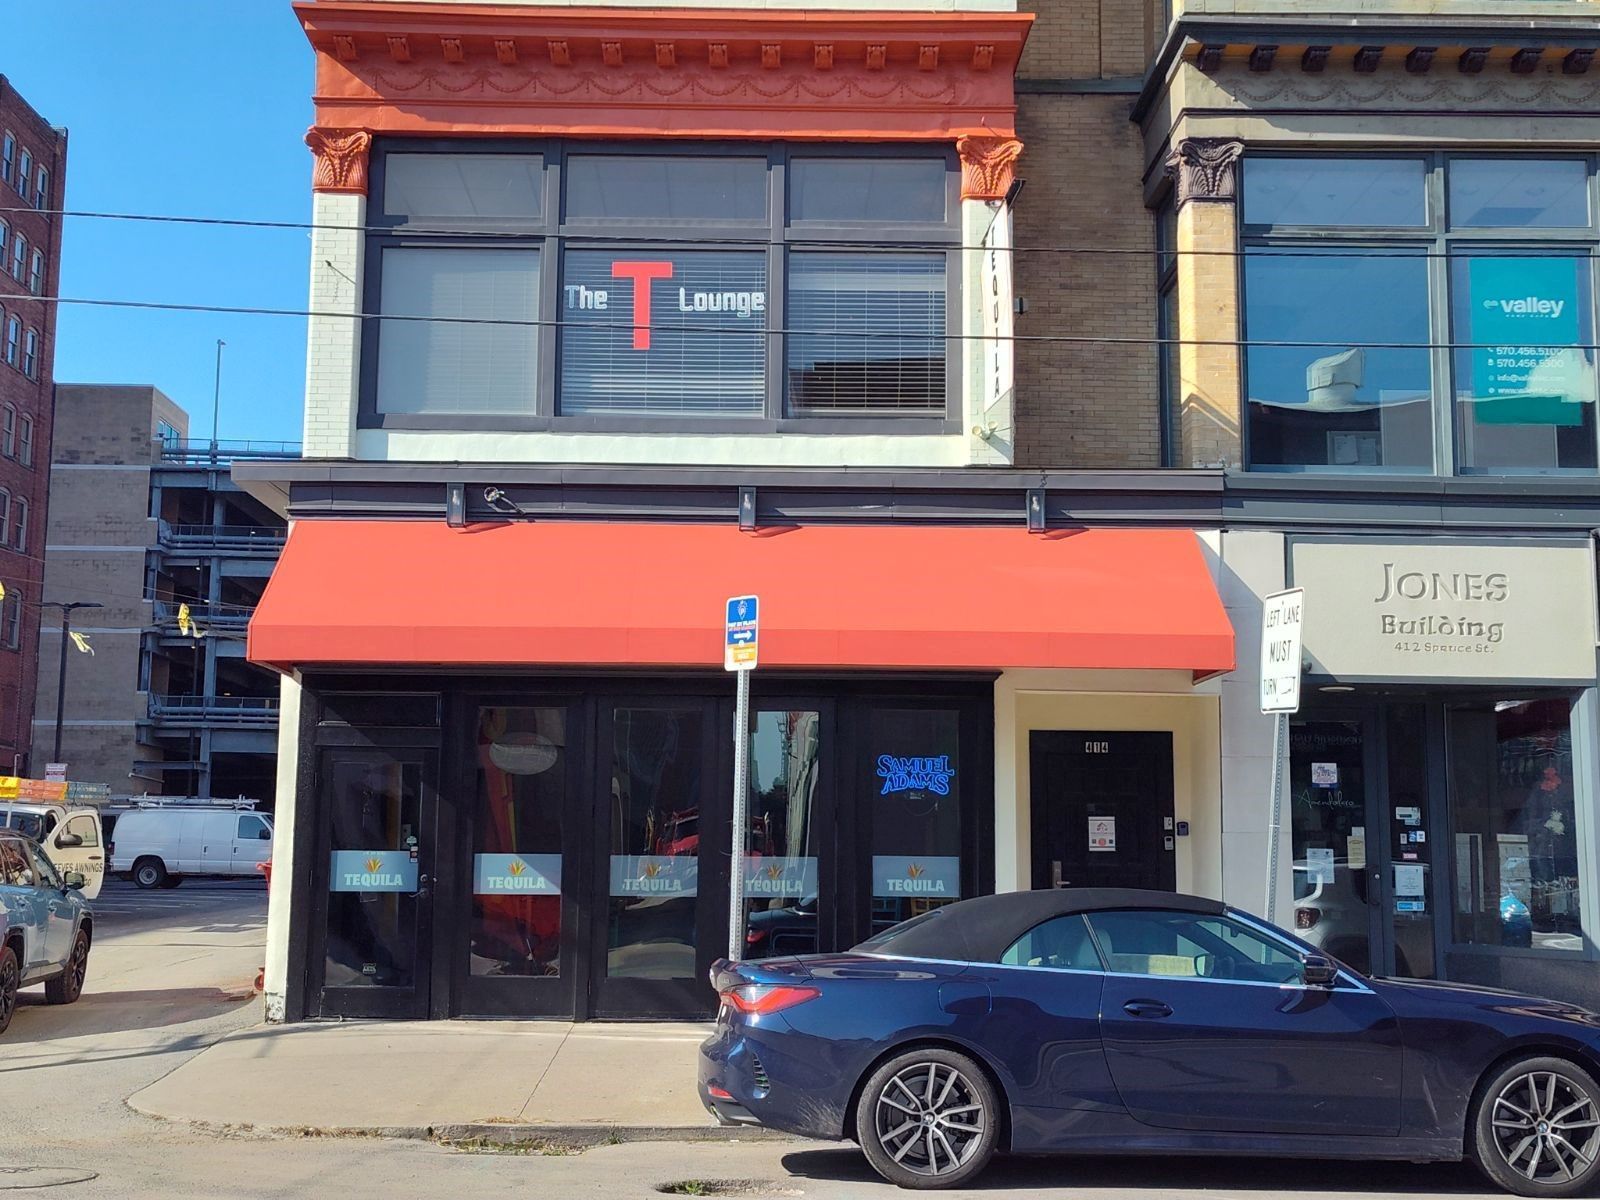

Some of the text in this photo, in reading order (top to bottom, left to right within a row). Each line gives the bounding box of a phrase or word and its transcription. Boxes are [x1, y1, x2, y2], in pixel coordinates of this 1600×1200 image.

[564, 261, 765, 350] The T Lounge
[990, 225, 1000, 400] TEQUILA
[1500, 296, 1564, 318] valley
[1374, 563, 1510, 603] JONES
[1266, 605, 1300, 628] LEFT LANE
[1381, 614, 1504, 643] Building
[1269, 639, 1292, 664] MUST
[1394, 642, 1421, 652] 412
[1475, 643, 1495, 653] St.
[1085, 741, 1109, 753] 414
[876, 754, 955, 777] SAMUEL
[880, 773, 950, 796] ADAMS
[75, 862, 104, 873] AWNINGS
[344, 873, 403, 887] TEQUILA
[487, 876, 546, 890] TEQUILA
[623, 878, 682, 893] TEQUILA
[745, 879, 803, 893] TEQUILA
[886, 879, 945, 893] TEQUILA
